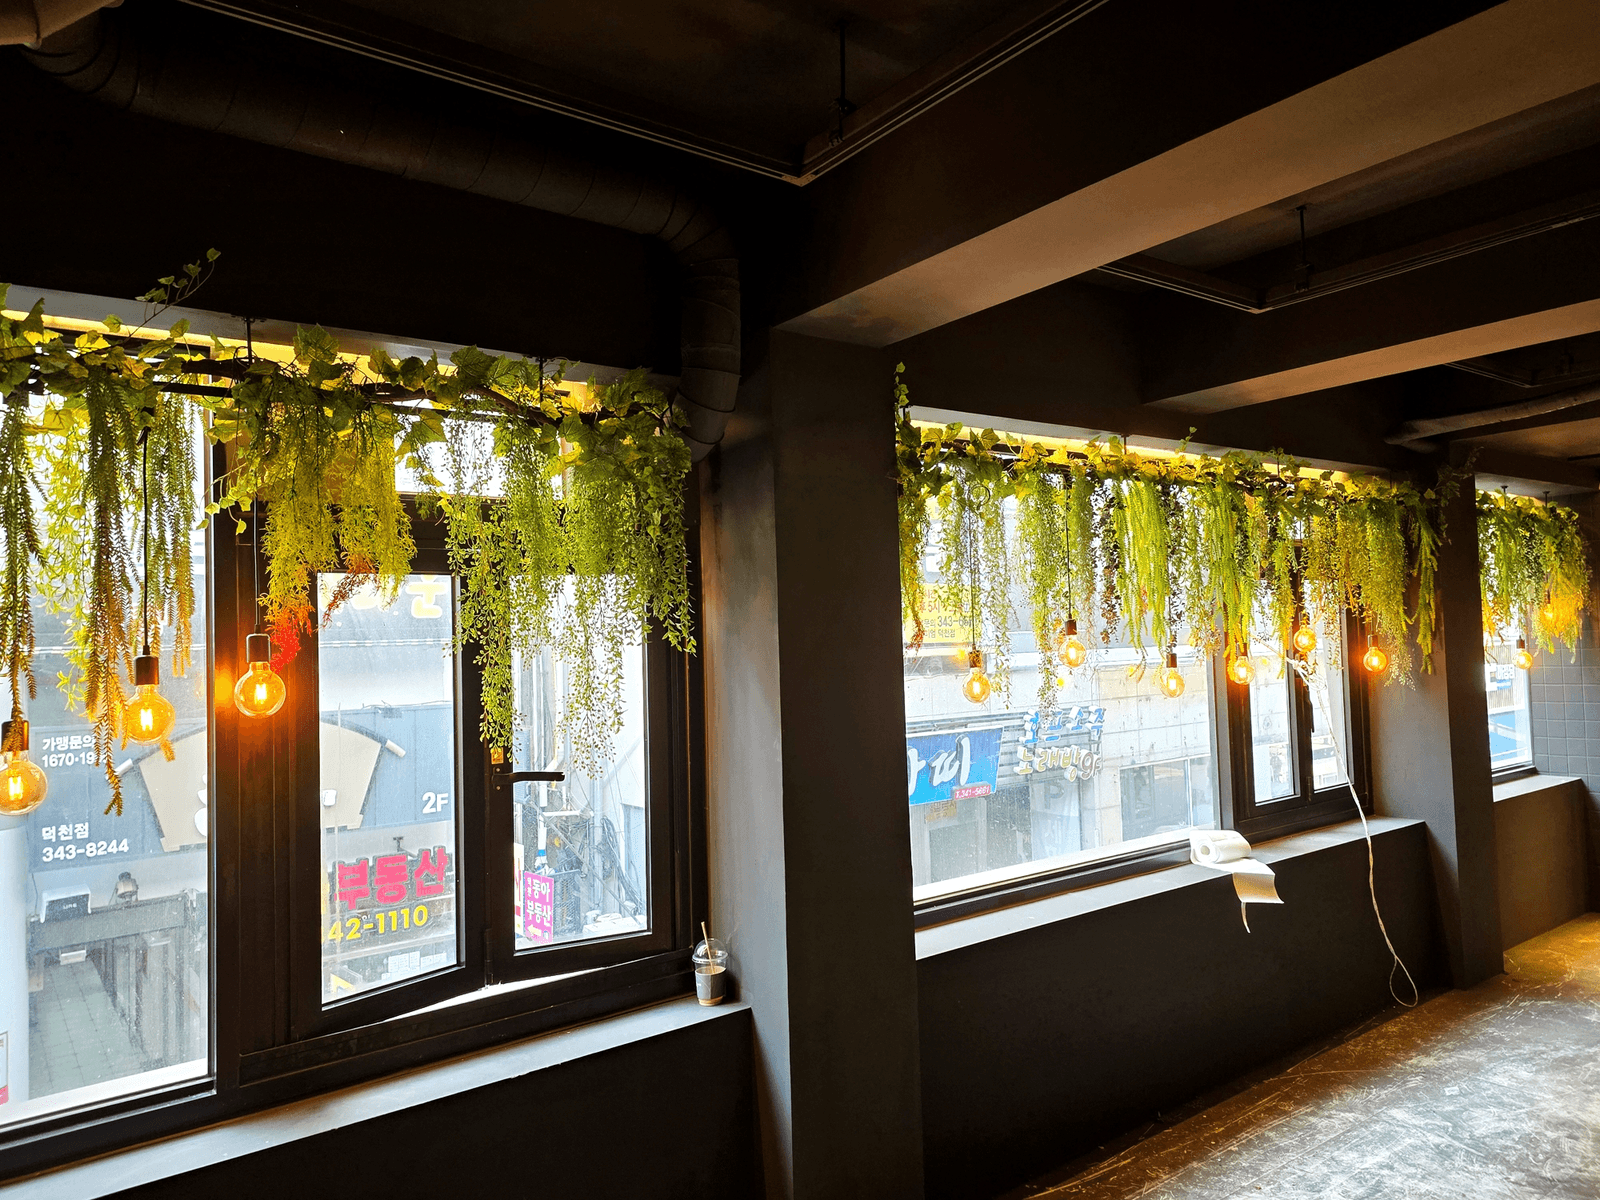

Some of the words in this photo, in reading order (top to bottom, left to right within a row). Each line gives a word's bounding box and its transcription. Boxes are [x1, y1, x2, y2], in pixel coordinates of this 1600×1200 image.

[42, 734, 97, 752] 가맹문의
[422, 791, 449, 814] 2F
[42, 822, 89, 842] 덕천점
[42, 838, 129, 862] 343-8244
[334, 847, 448, 910] 부동산
[526, 900, 552, 927] 부동산
